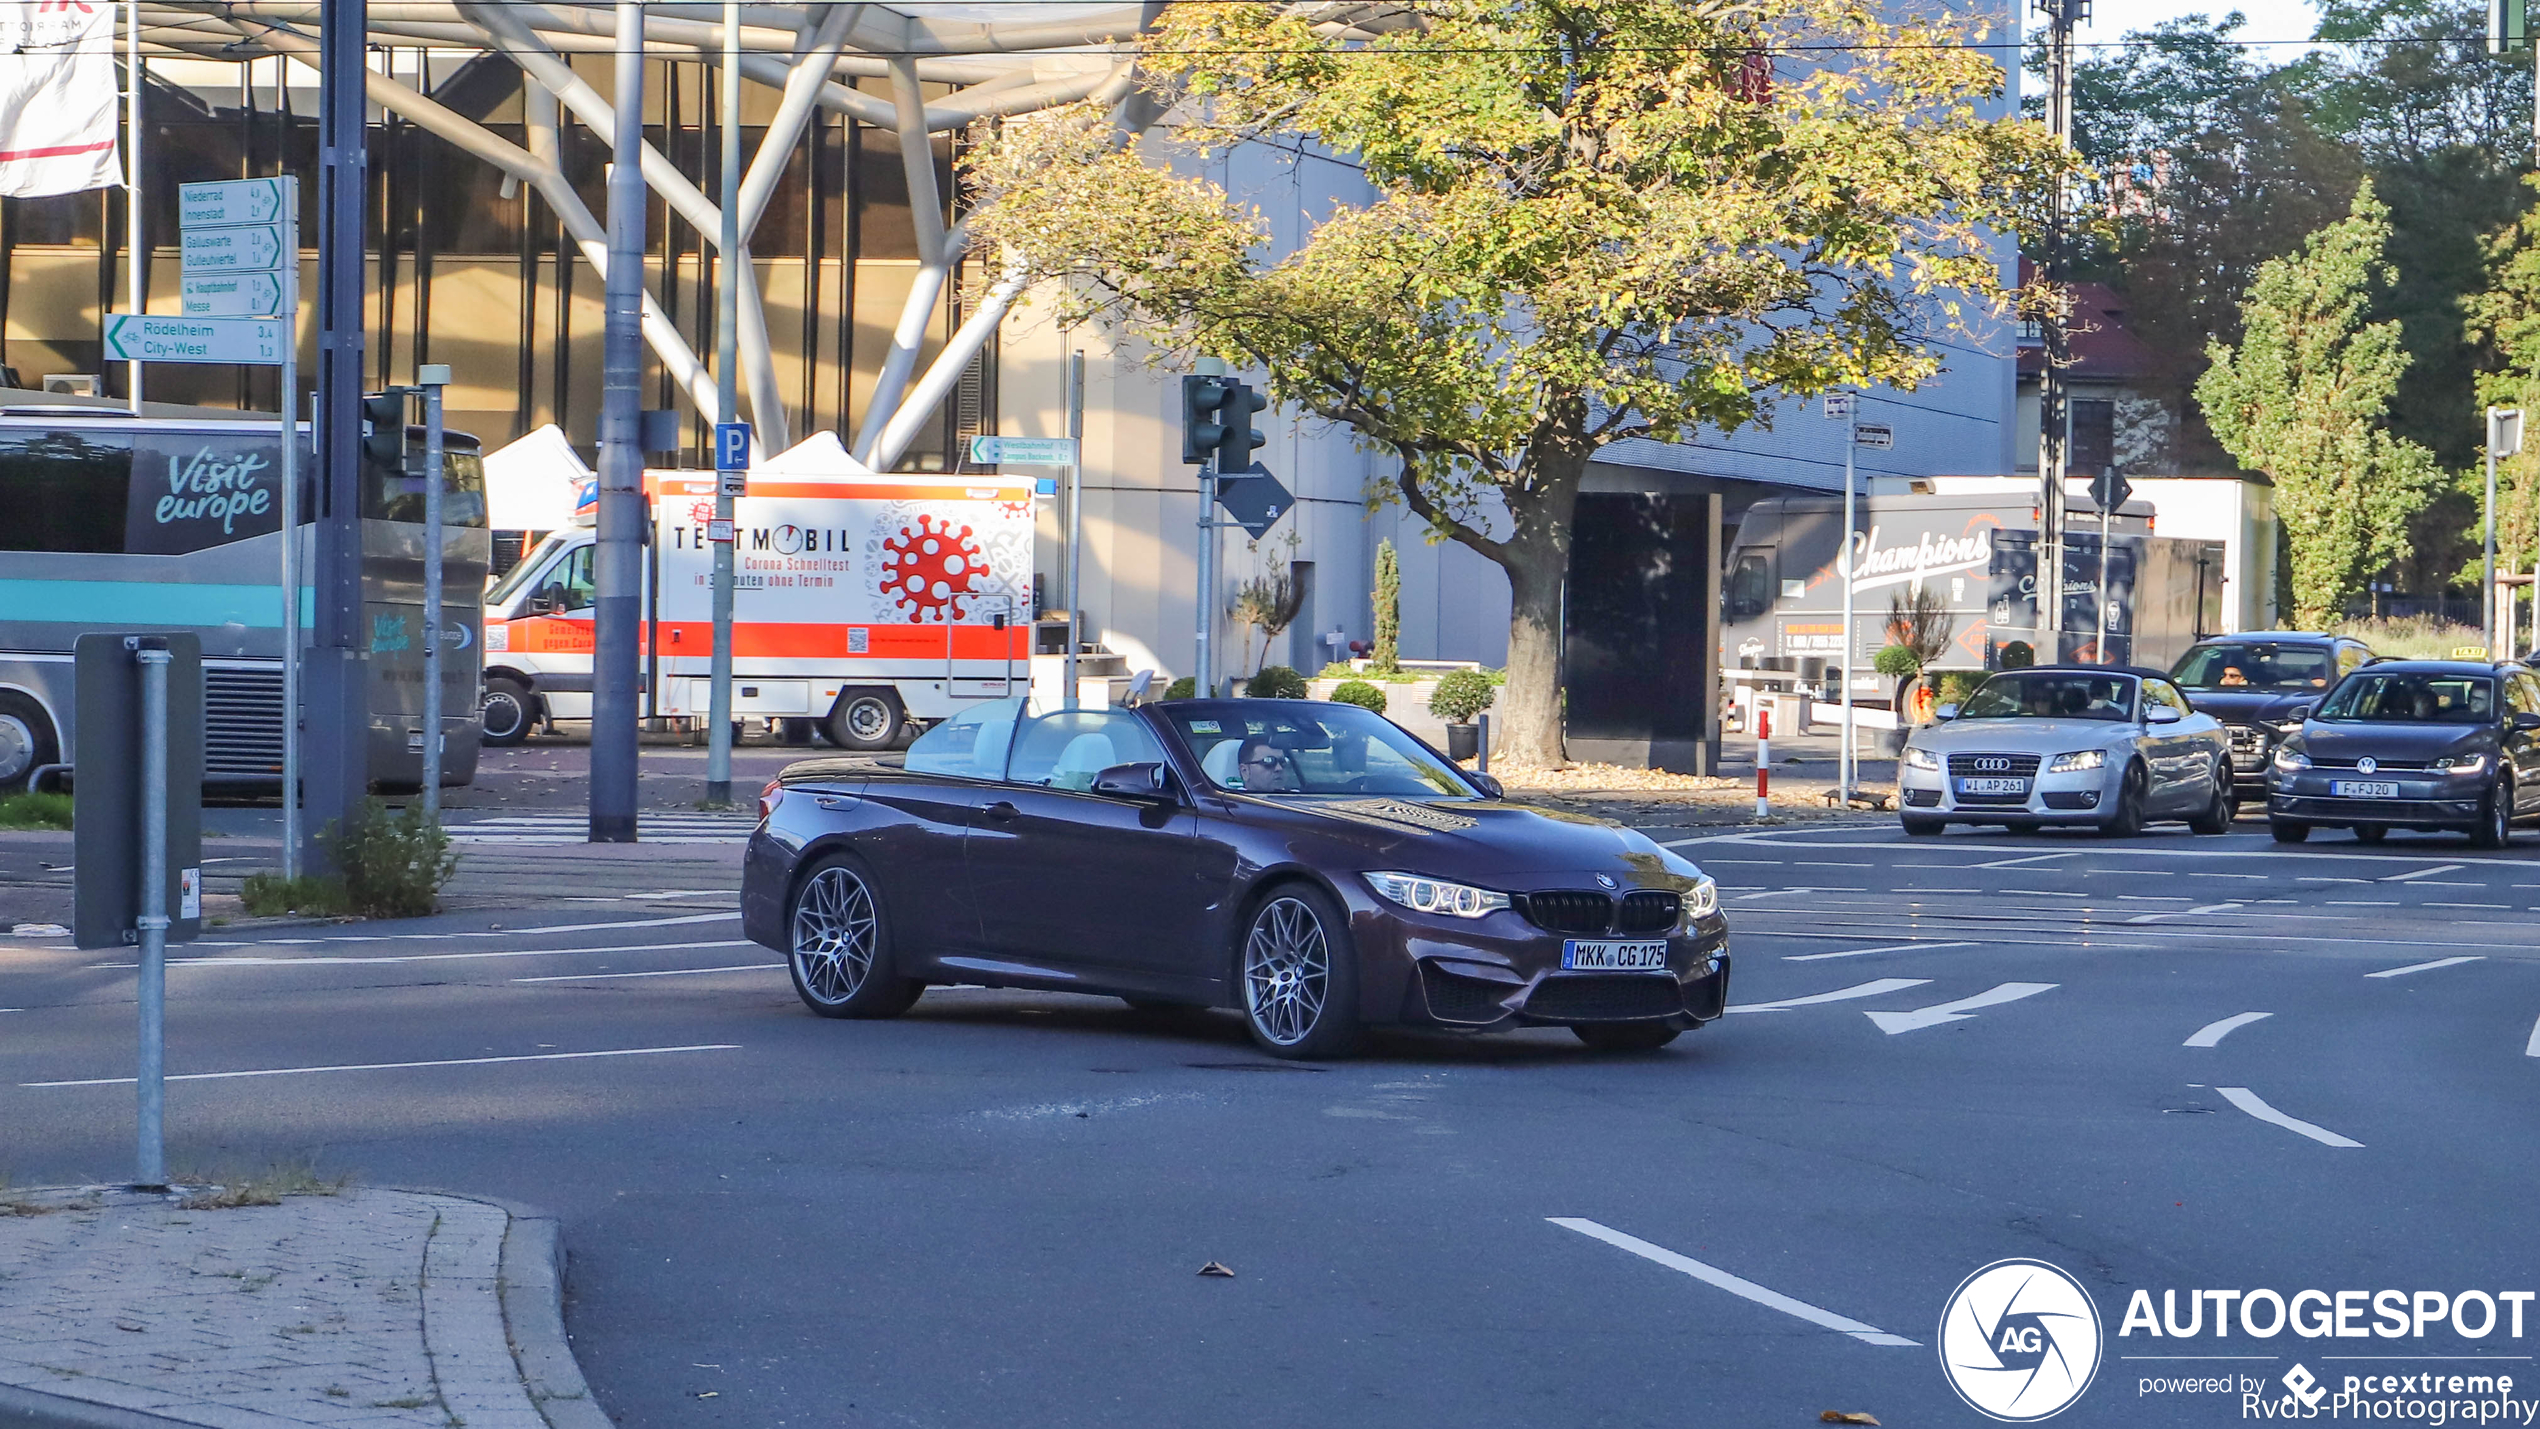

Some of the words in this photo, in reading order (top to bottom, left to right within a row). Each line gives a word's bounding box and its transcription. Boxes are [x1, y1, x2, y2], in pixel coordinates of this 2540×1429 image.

[184, 188, 224, 202] Niederrad
[185, 206, 225, 220] Innenstadt
[186, 235, 231, 248] Galluswarte
[186, 252, 237, 266] Gutleutviertel
[186, 300, 210, 312] Messe
[144, 322, 214, 337] Rödelheim
[144, 341, 207, 356] City-West
[726, 429, 744, 464] P
[1003, 441, 1053, 450] Westbahnhof
[169, 445, 269, 494] Visit
[155, 488, 270, 534] europe
[745, 557, 782, 571] Corona
[787, 557, 850, 571] Schnelltest
[1836, 525, 1991, 600] Champions
[694, 572, 705, 586] in
[768, 574, 793, 587] ohne
[798, 574, 834, 587] Termin
[2455, 647, 2482, 656] TAXI
[1965, 780, 1978, 791] WI
[1986, 780, 2000, 791] AP
[2002, 780, 2022, 792] 261
[1574, 944, 1607, 966] MKK
[1618, 945, 1637, 966] CG
[1639, 945, 1665, 966] 175
